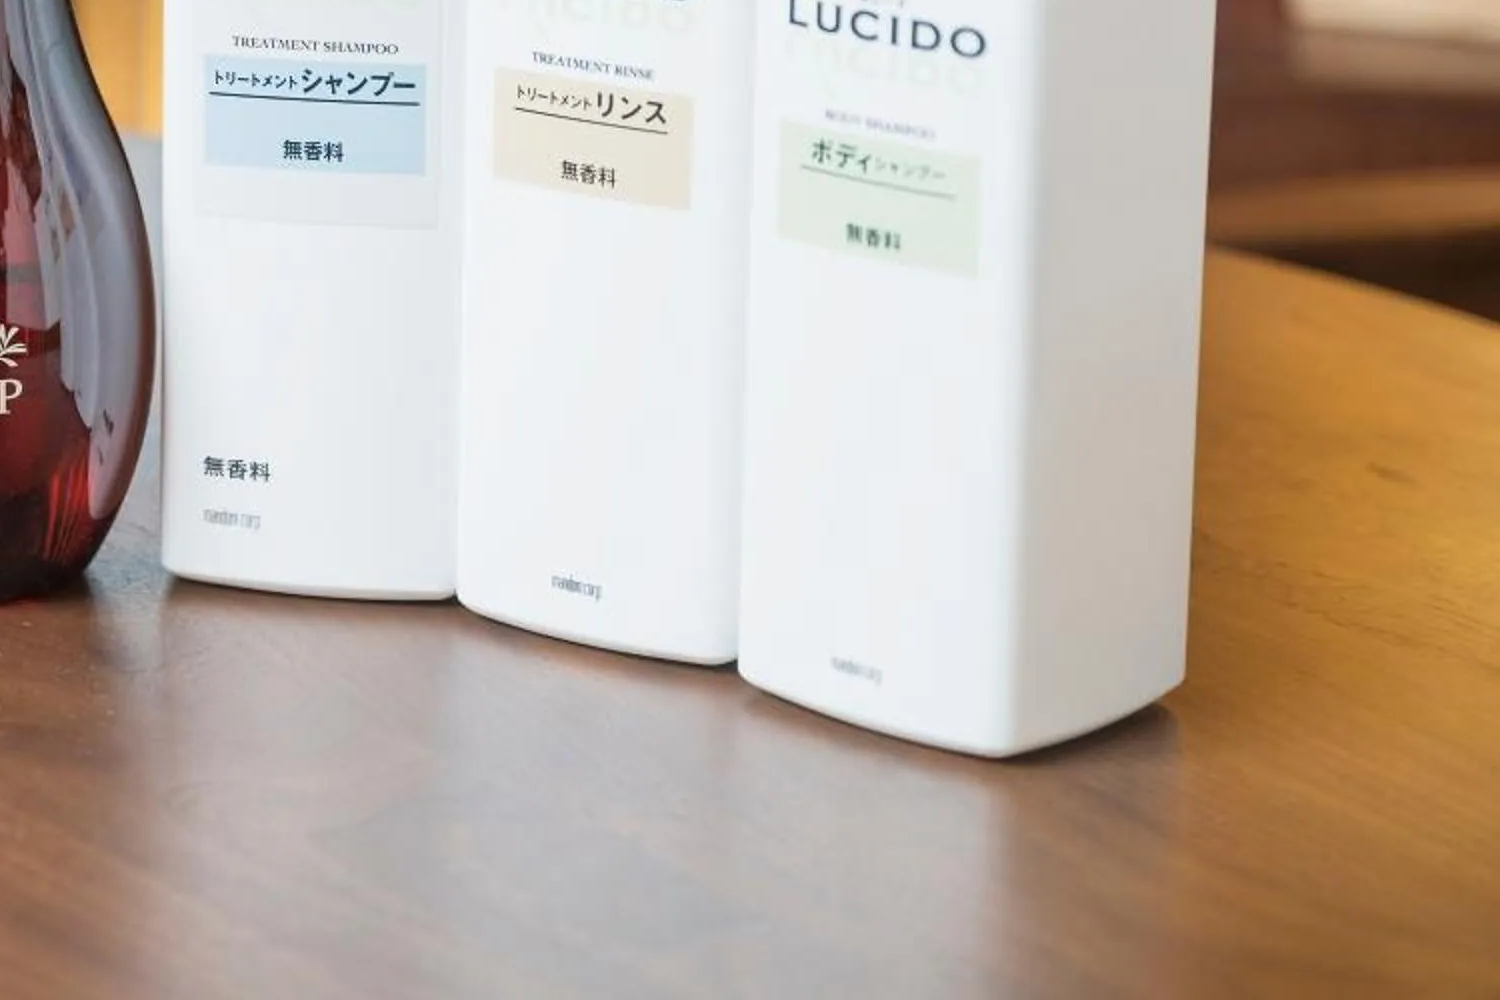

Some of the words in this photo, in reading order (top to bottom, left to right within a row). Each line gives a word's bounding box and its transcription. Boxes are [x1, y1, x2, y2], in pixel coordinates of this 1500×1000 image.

[232, 35, 320, 51] TREATMENT
[323, 41, 399, 55] SHAMPOO
[532, 52, 611, 75] TREATMENT
[615, 63, 654, 80] RINSE
[283, 140, 343, 162] 無香料
[561, 161, 616, 188] 無香料
[203, 456, 270, 481] 無香料
